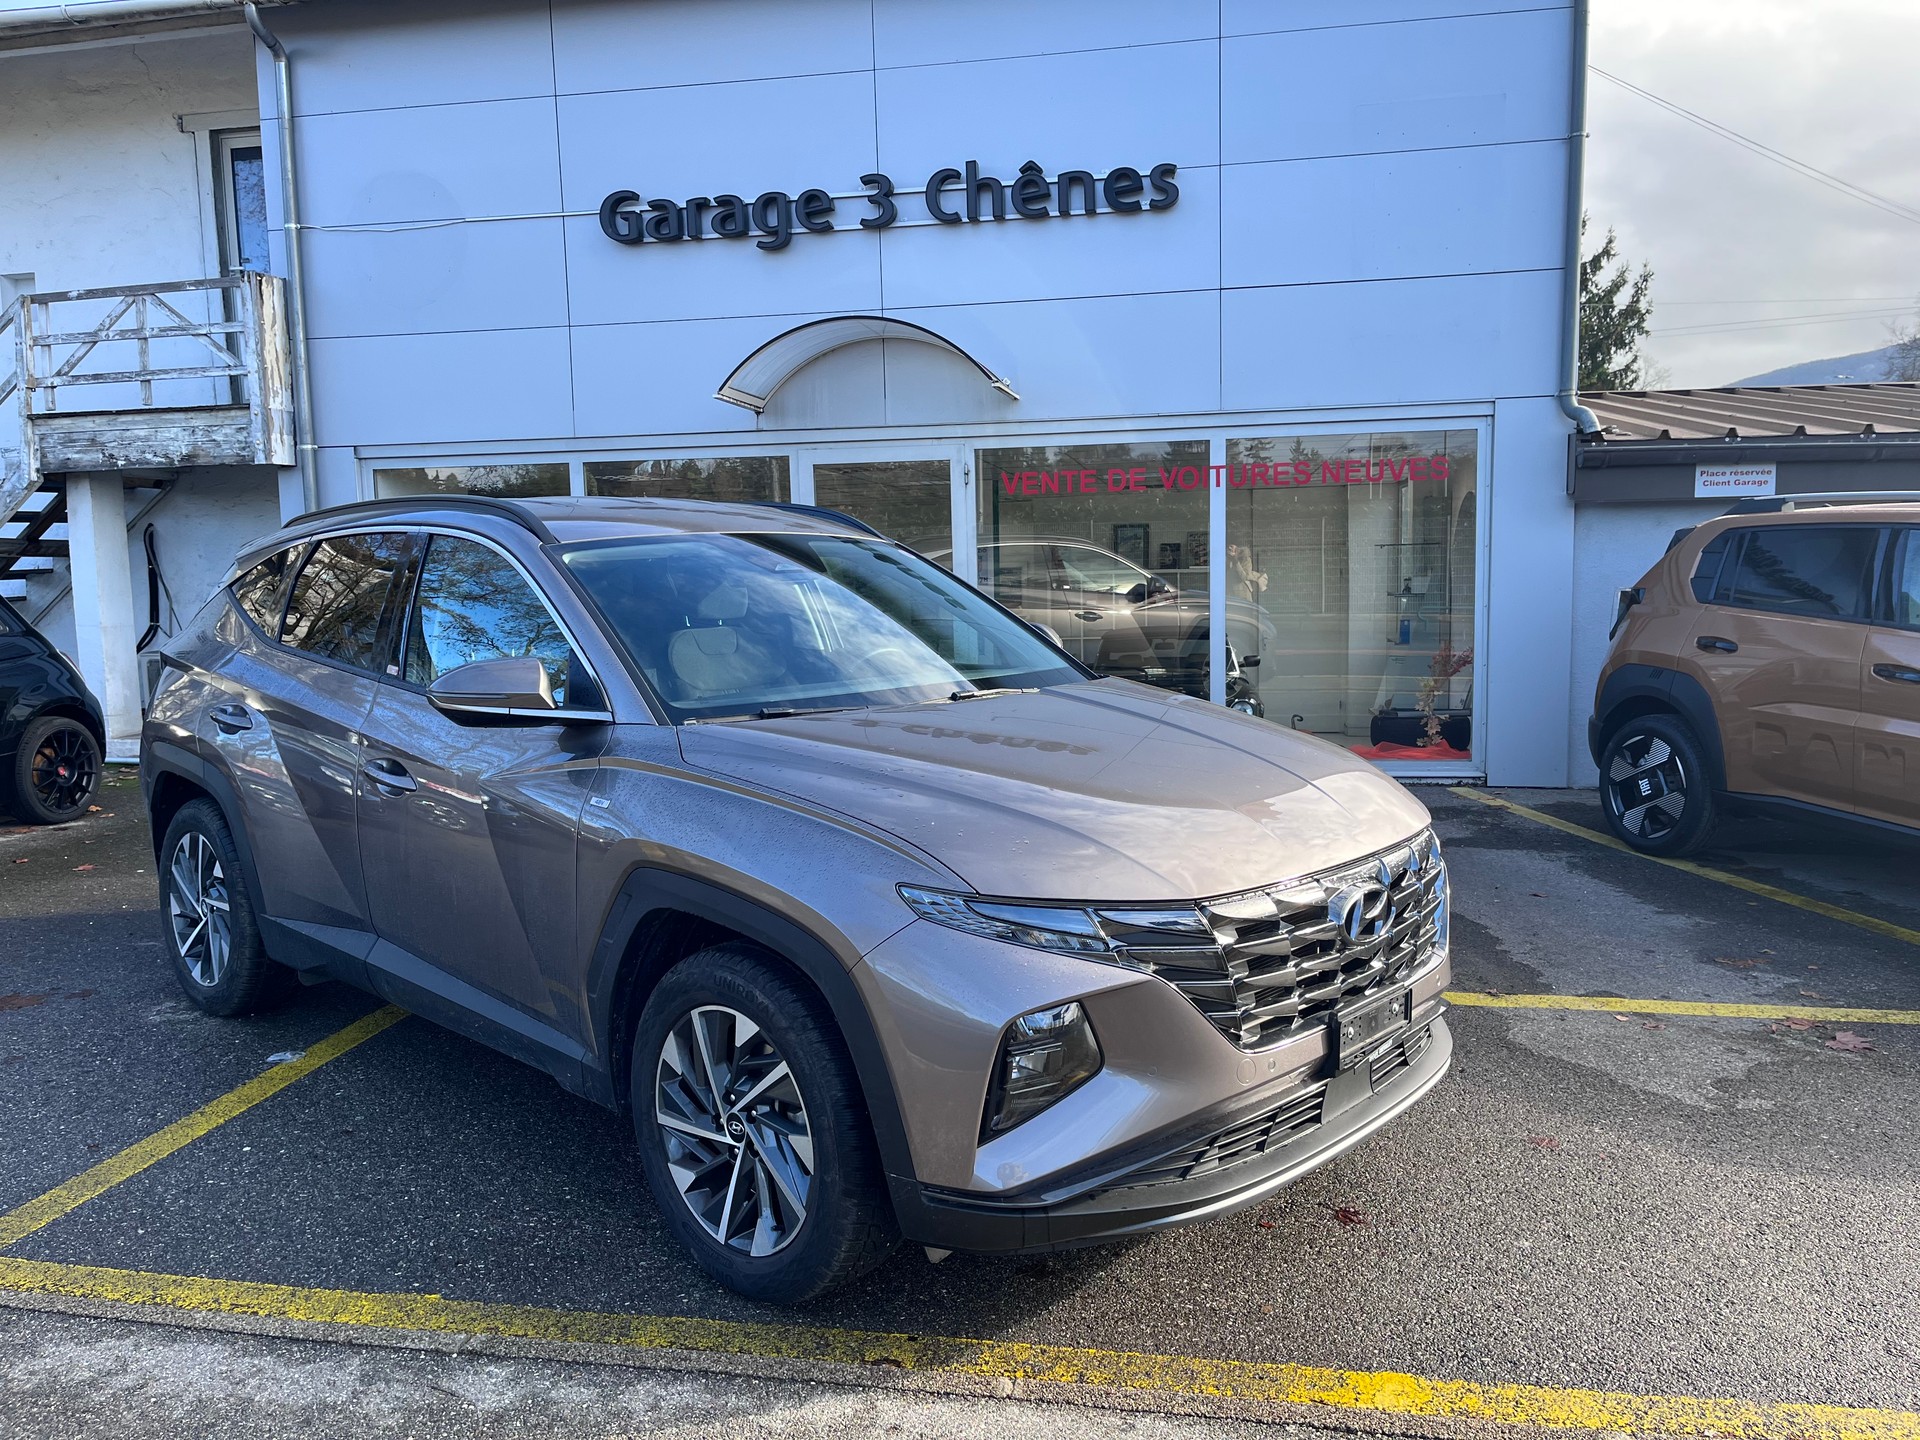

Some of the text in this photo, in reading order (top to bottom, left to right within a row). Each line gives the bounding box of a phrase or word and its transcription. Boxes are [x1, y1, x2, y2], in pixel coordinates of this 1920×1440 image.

[600, 159, 1180, 252] Garage 3 Chênes
[1000, 456, 1450, 496] VENTE DE VOITURES NEUVES
[1700, 469, 1727, 477] Place
[1638, 777, 1652, 796] FIAT
